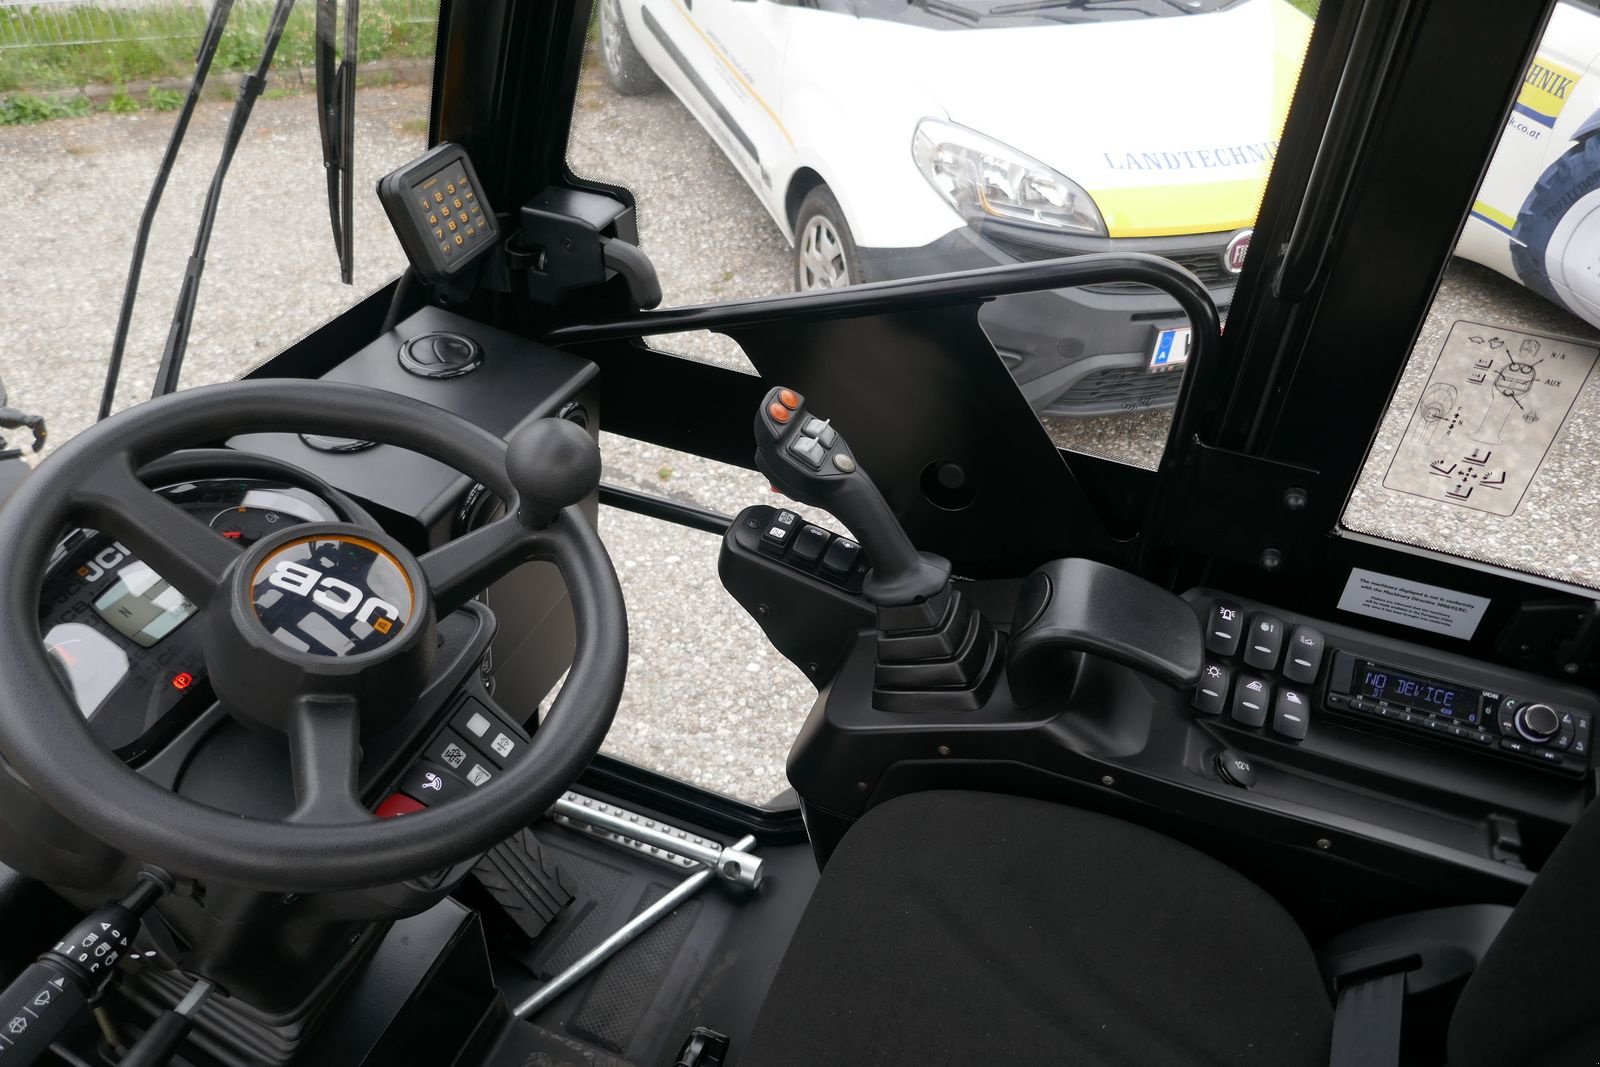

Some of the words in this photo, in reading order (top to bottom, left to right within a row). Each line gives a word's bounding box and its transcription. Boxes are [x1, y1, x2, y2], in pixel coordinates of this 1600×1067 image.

[435, 192, 443, 202] 2
[447, 184, 455, 194] 3
[442, 206, 450, 216] 5
[454, 199, 462, 208] 6
[448, 221, 456, 230] 8
[460, 213, 468, 222] 9
[455, 234, 463, 244] 0
[1544, 378, 1561, 388] AUX
[84, 541, 132, 582] JC
[268, 560, 400, 624] JCB
[1365, 672, 1387, 689] NO
[1395, 679, 1455, 706] DEVICE
